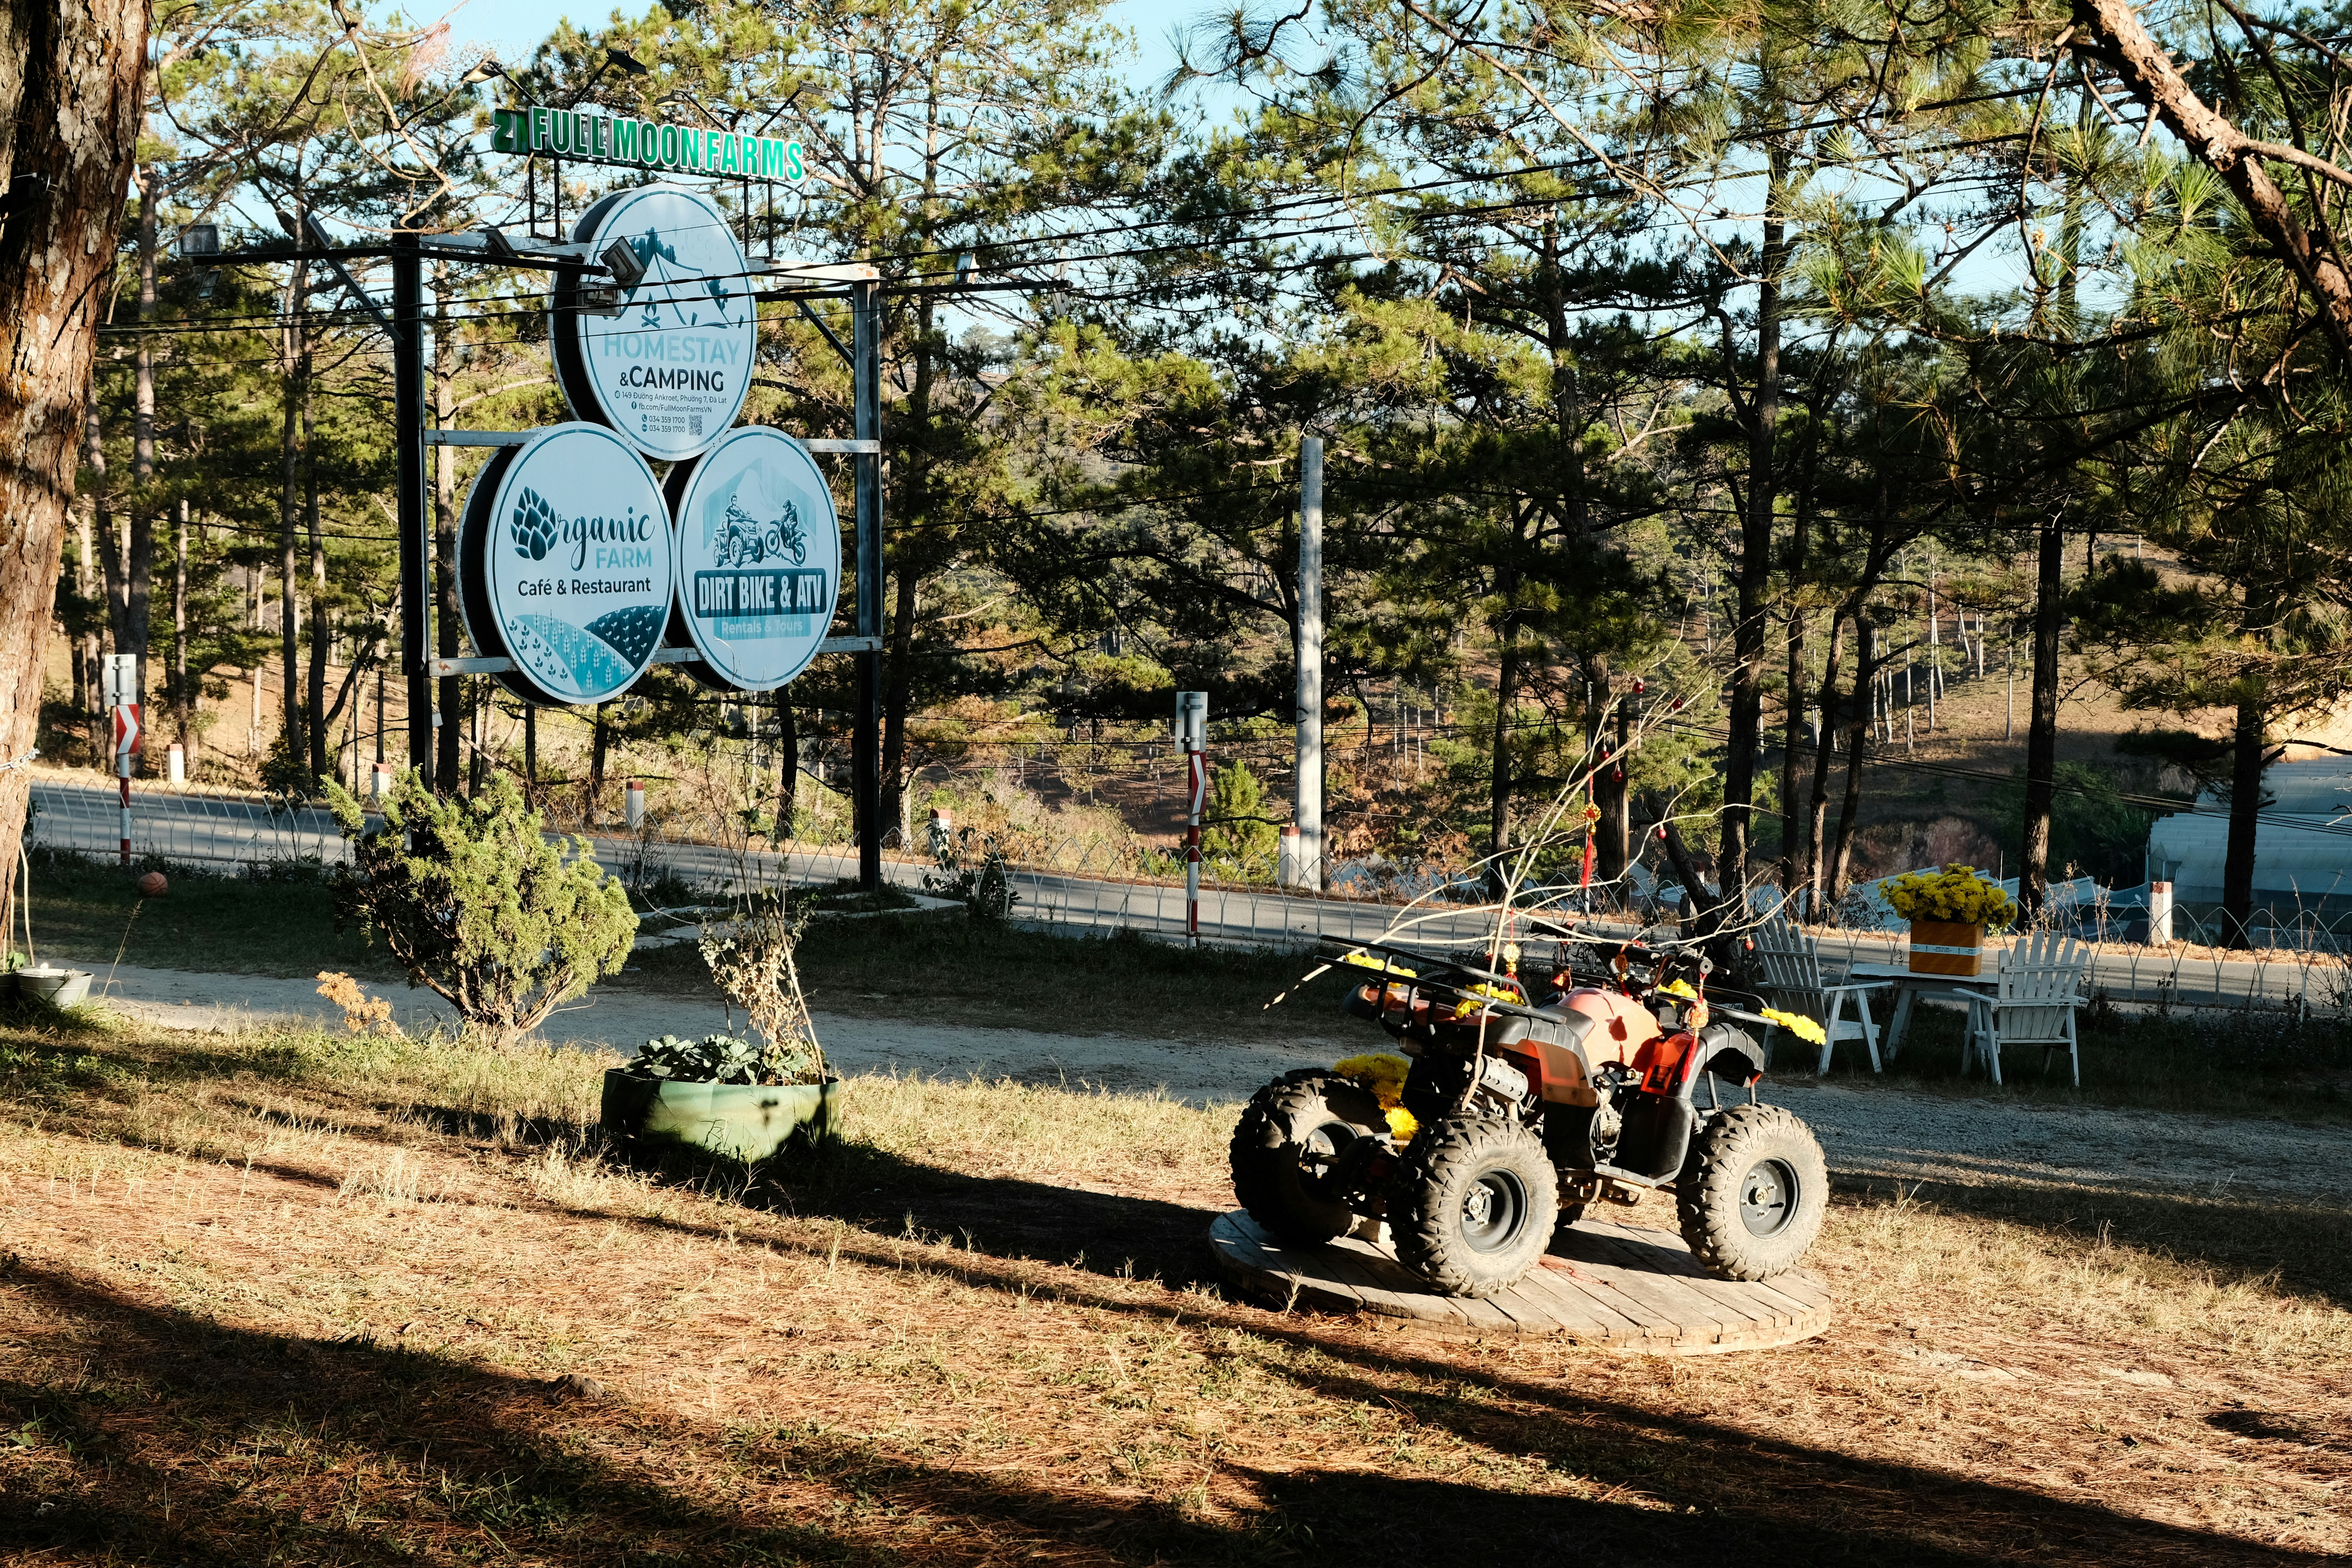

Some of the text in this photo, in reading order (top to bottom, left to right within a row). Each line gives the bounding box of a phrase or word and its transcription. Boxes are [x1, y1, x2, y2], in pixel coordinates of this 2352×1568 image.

[529, 106, 607, 158] FULL
[611, 117, 700, 170] MOON
[703, 129, 804, 182] FARMS
[605, 329, 741, 364] HOMESTAY
[633, 392, 653, 401] Đường
[654, 394, 679, 403] Ankroet,
[680, 395, 702, 404] Phường
[718, 397, 727, 405] Lạt
[639, 403, 712, 413] fb.com/FullMoonFarmsVN
[596, 547, 652, 569] FARM
[518, 577, 651, 596] Café & Restaurant
[699, 575, 822, 610] DIRT BIKE & ATV
[721, 620, 802, 634] Rentals & Tours
